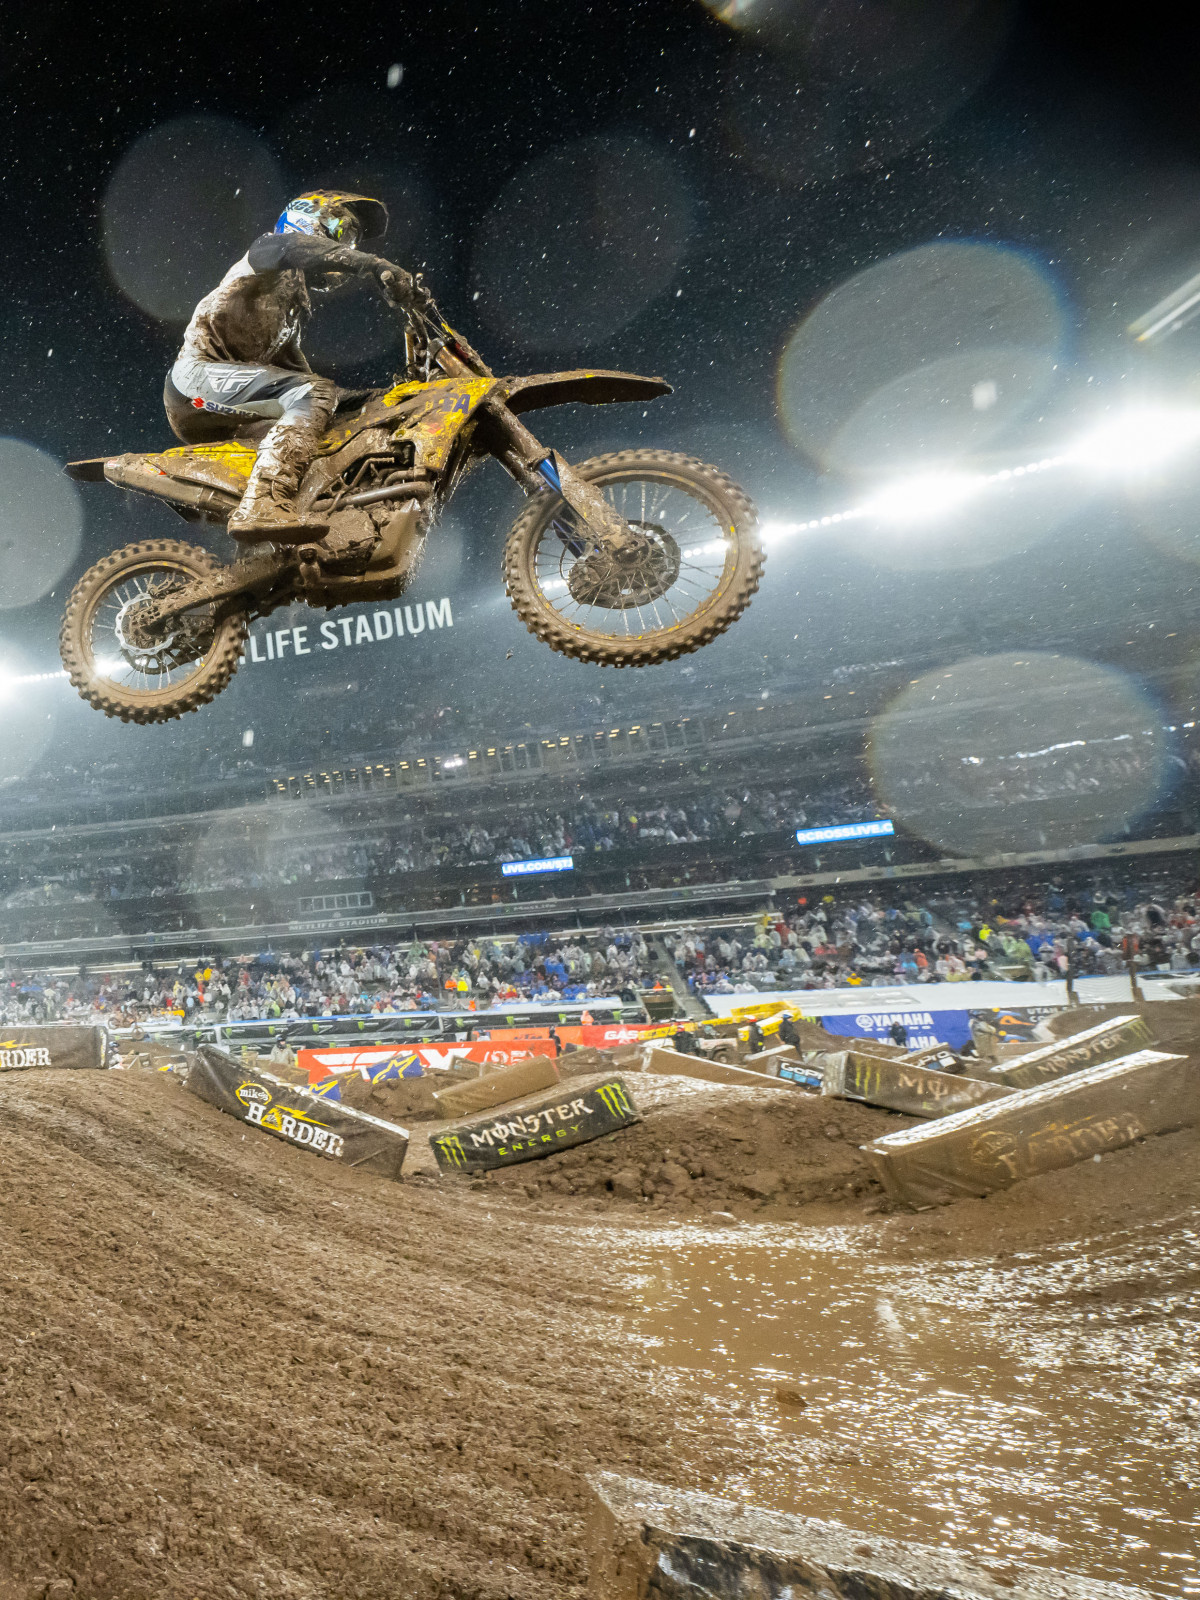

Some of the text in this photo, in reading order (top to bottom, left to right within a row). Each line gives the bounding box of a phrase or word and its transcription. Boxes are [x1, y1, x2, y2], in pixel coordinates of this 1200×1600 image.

[319, 597, 454, 651] STADIUM
[338, 917, 389, 928] STADIUM
[871, 1013, 935, 1027] YAMAHA
[781, 1062, 825, 1080] GoPr
[244, 1101, 345, 1157] HARDER
[470, 1098, 594, 1147] MONSTER
[497, 1122, 580, 1156] ENERGY
